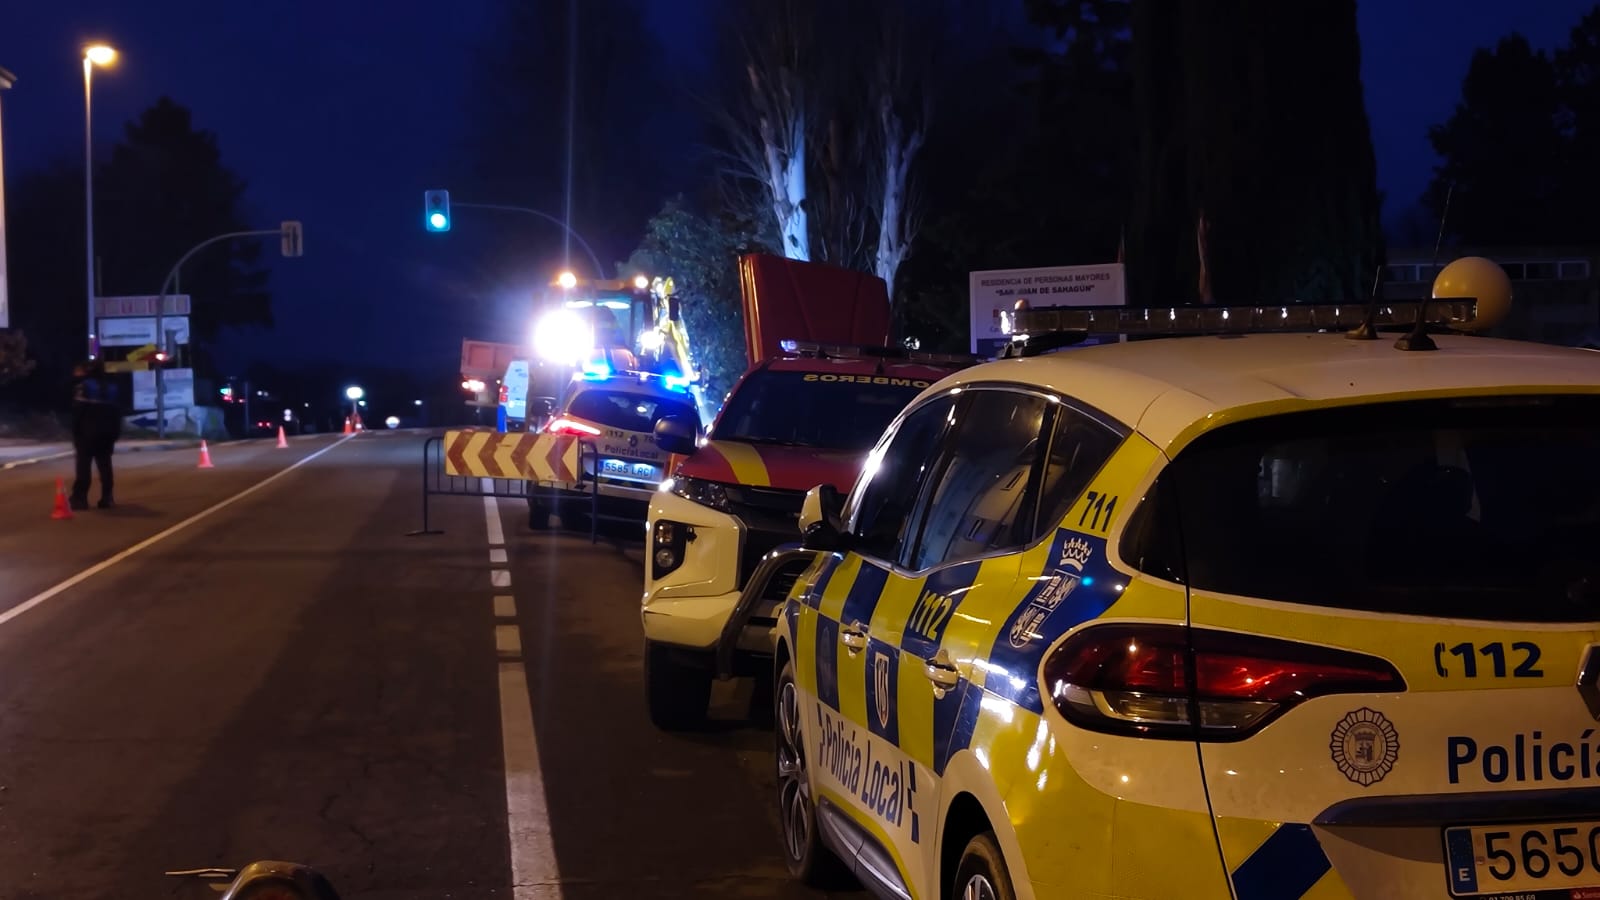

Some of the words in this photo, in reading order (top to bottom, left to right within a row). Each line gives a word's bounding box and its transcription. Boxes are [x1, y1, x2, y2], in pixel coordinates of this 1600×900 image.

[981, 278, 1022, 287] RESIDENCIA
[1023, 277, 1033, 285] DE
[1034, 275, 1073, 284] PERSONAS
[1075, 273, 1111, 281] MAYORES
[1040, 286, 1049, 294] DE
[1079, 491, 1118, 532] 711
[916, 594, 952, 641] 112
[1449, 641, 1544, 678] 112
[825, 716, 861, 796] Policía
[861, 739, 904, 827] Local
[1447, 729, 1600, 784] Policí
[1459, 868, 1470, 882] E
